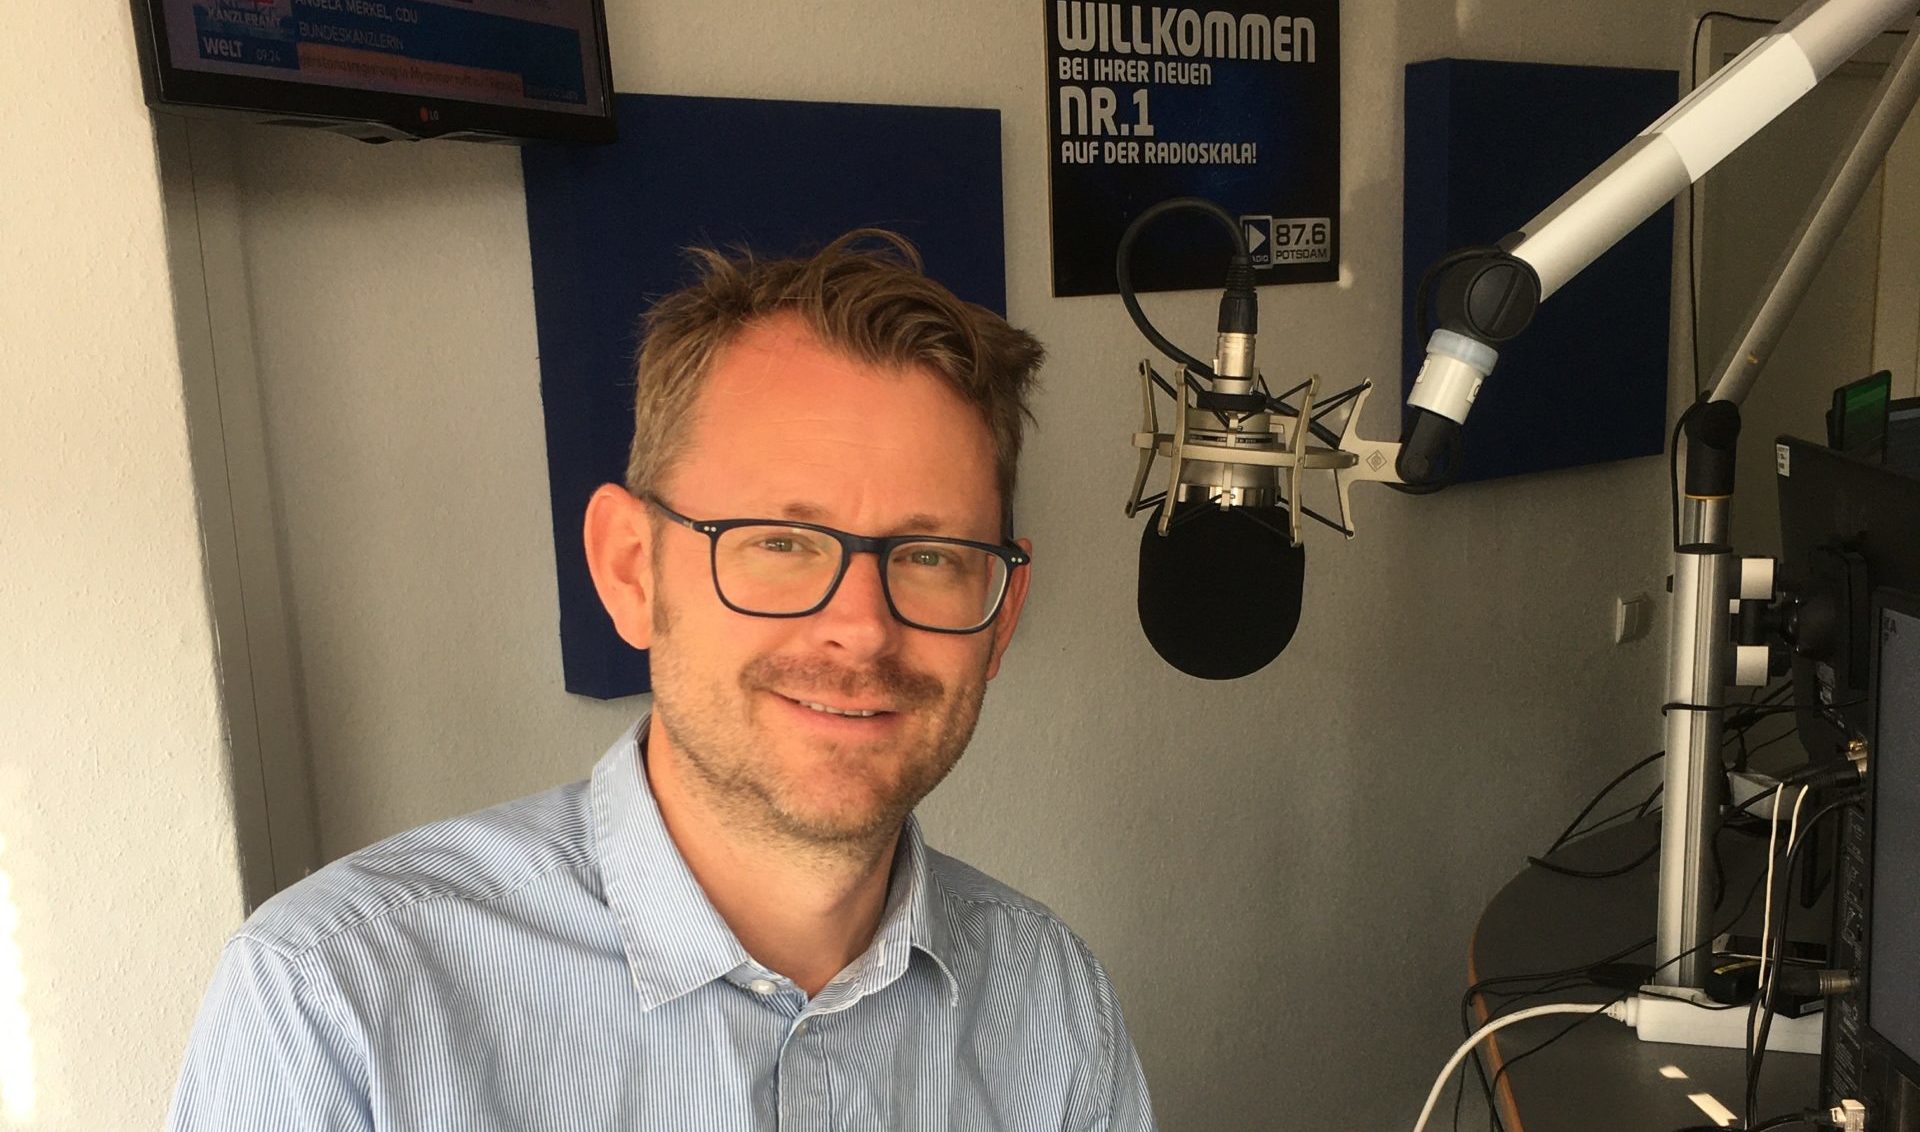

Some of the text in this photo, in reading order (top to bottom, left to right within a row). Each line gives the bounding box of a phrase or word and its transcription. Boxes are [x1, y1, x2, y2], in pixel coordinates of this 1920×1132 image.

[207, 7, 280, 28] KANZLERAMT
[395, 6, 418, 24] CDU
[298, 20, 404, 50] BUNDESKANZLERIN
[1056, 0, 1317, 63] WILLKOMMEN
[1058, 57, 1212, 85] BEI IHRER NEUEN
[1059, 86, 1155, 137] NR.1
[1061, 141, 1257, 165] AUF DER RADIOSKALA!
[1276, 223, 1326, 246] 87.6
[1276, 248, 1327, 260] POTSDAM
